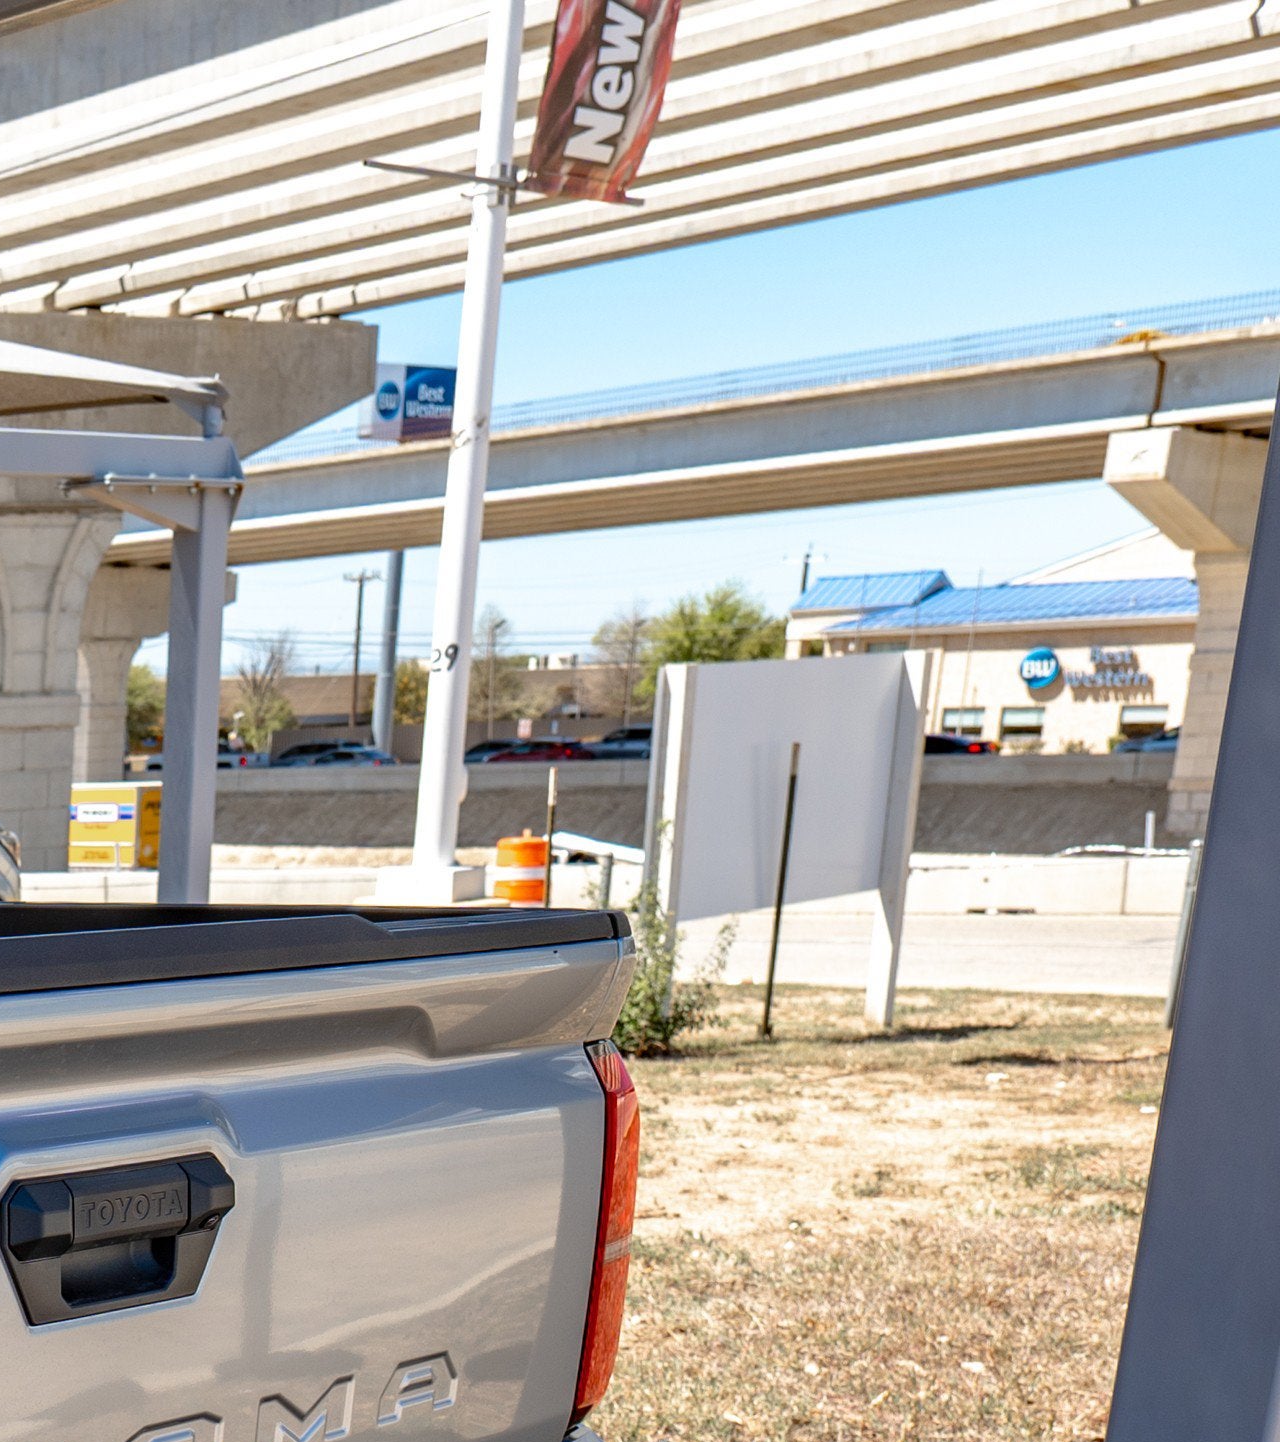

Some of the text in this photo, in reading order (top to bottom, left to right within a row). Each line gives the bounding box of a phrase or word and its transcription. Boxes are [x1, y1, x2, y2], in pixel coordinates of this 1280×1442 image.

[562, 0, 646, 165] New
[1091, 644, 1134, 664] Best
[80, 1189, 183, 1229] TOYOTA
